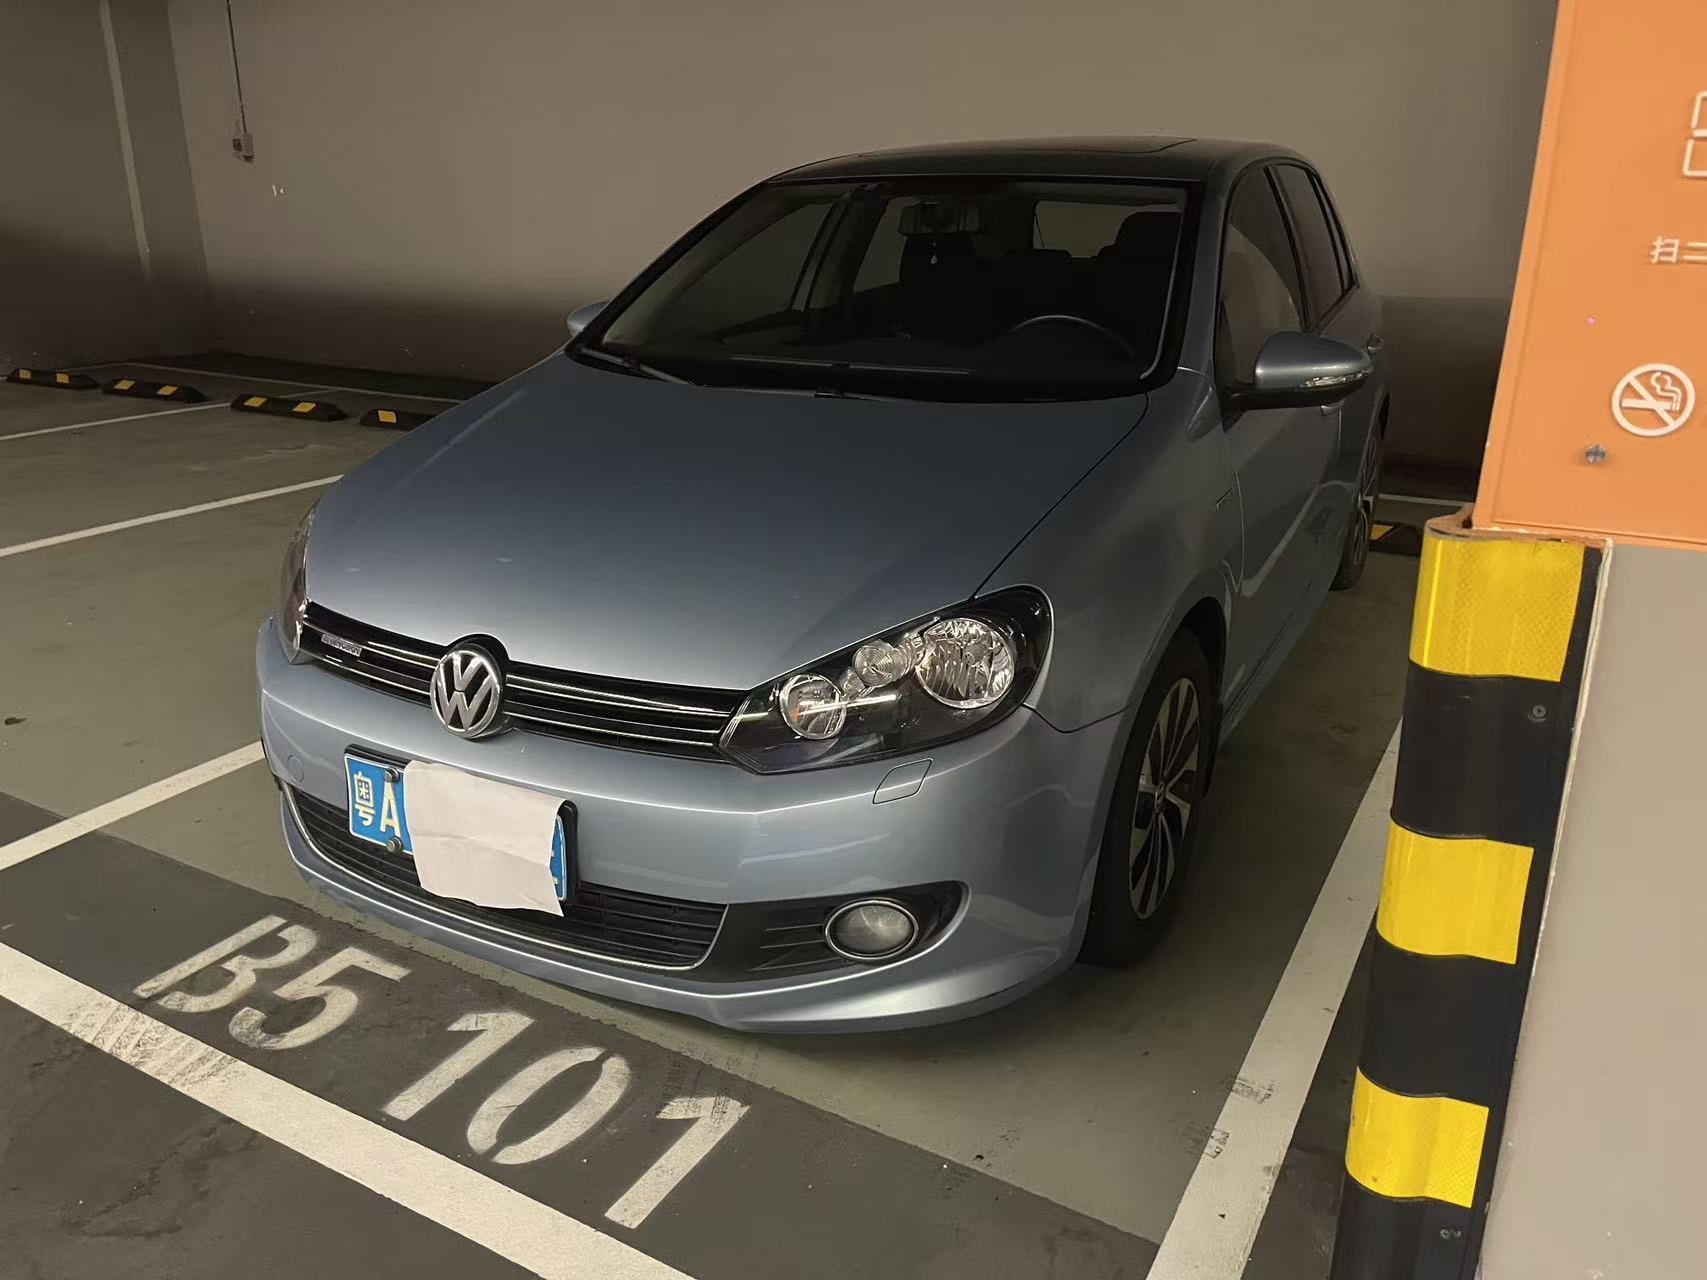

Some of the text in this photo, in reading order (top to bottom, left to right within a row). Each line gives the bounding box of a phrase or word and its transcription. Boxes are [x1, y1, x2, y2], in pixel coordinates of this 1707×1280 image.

[433, 651, 497, 735] VW
[133, 915, 751, 1229] B5 101
